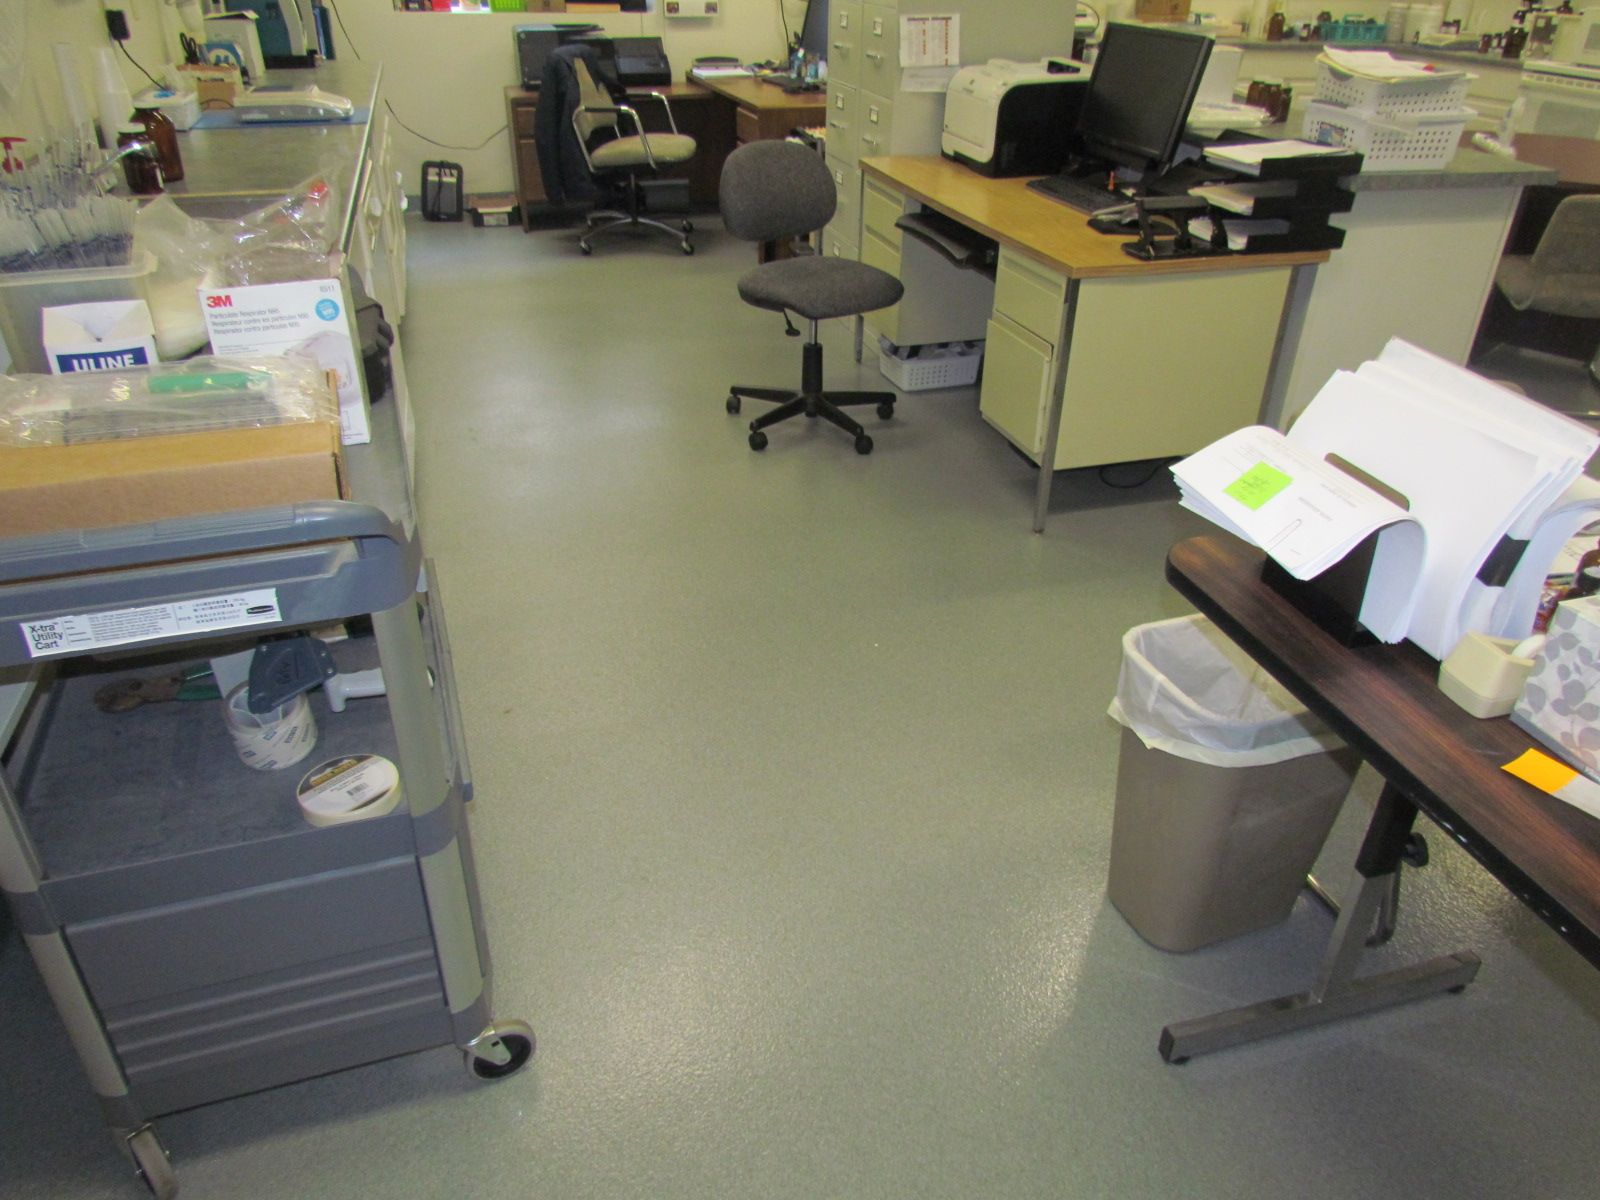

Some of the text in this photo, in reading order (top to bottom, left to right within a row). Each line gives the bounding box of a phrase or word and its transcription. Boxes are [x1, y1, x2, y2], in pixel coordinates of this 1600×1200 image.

[206, 295, 233, 308] 3M
[32, 631, 64, 642] Utility
[35, 640, 59, 650] Cart
